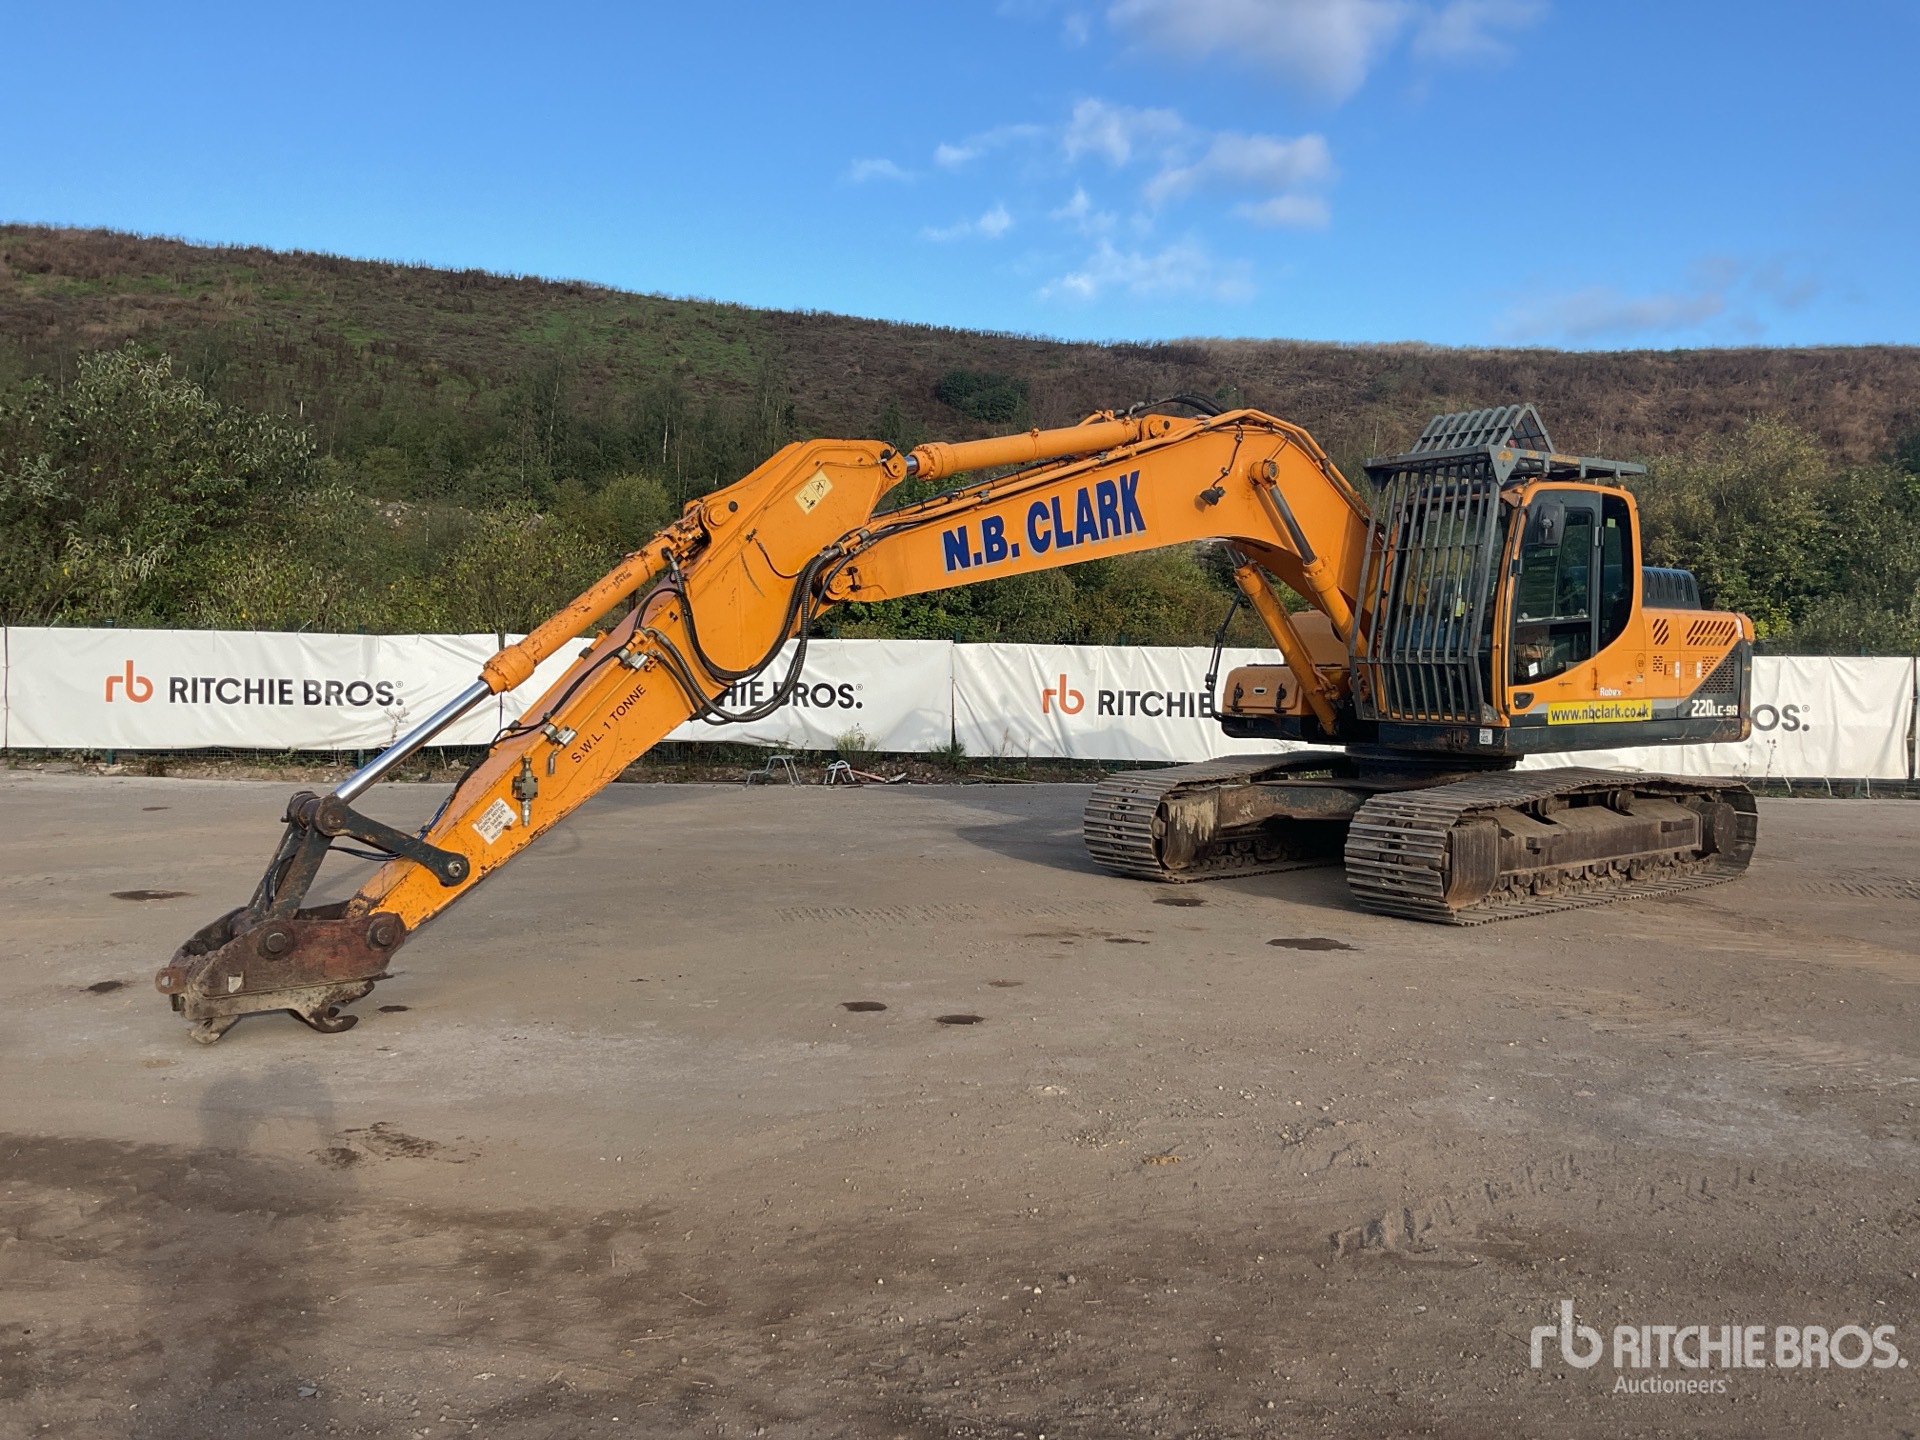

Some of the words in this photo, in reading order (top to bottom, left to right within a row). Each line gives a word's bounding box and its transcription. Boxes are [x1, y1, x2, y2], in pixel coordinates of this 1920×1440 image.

[941, 513, 1021, 573] N.B.
[1026, 469, 1148, 556] CLARK
[105, 660, 153, 703] rb
[169, 676, 293, 705] RITCHIE
[303, 680, 404, 707] BROS.
[1042, 674, 1084, 715] rb
[1098, 690, 1212, 718] RITCHIE
[571, 733, 605, 763] S.W.L.
[603, 721, 611, 730] 1
[609, 684, 647, 722] TONNE
[1751, 704, 1810, 732] OS.
